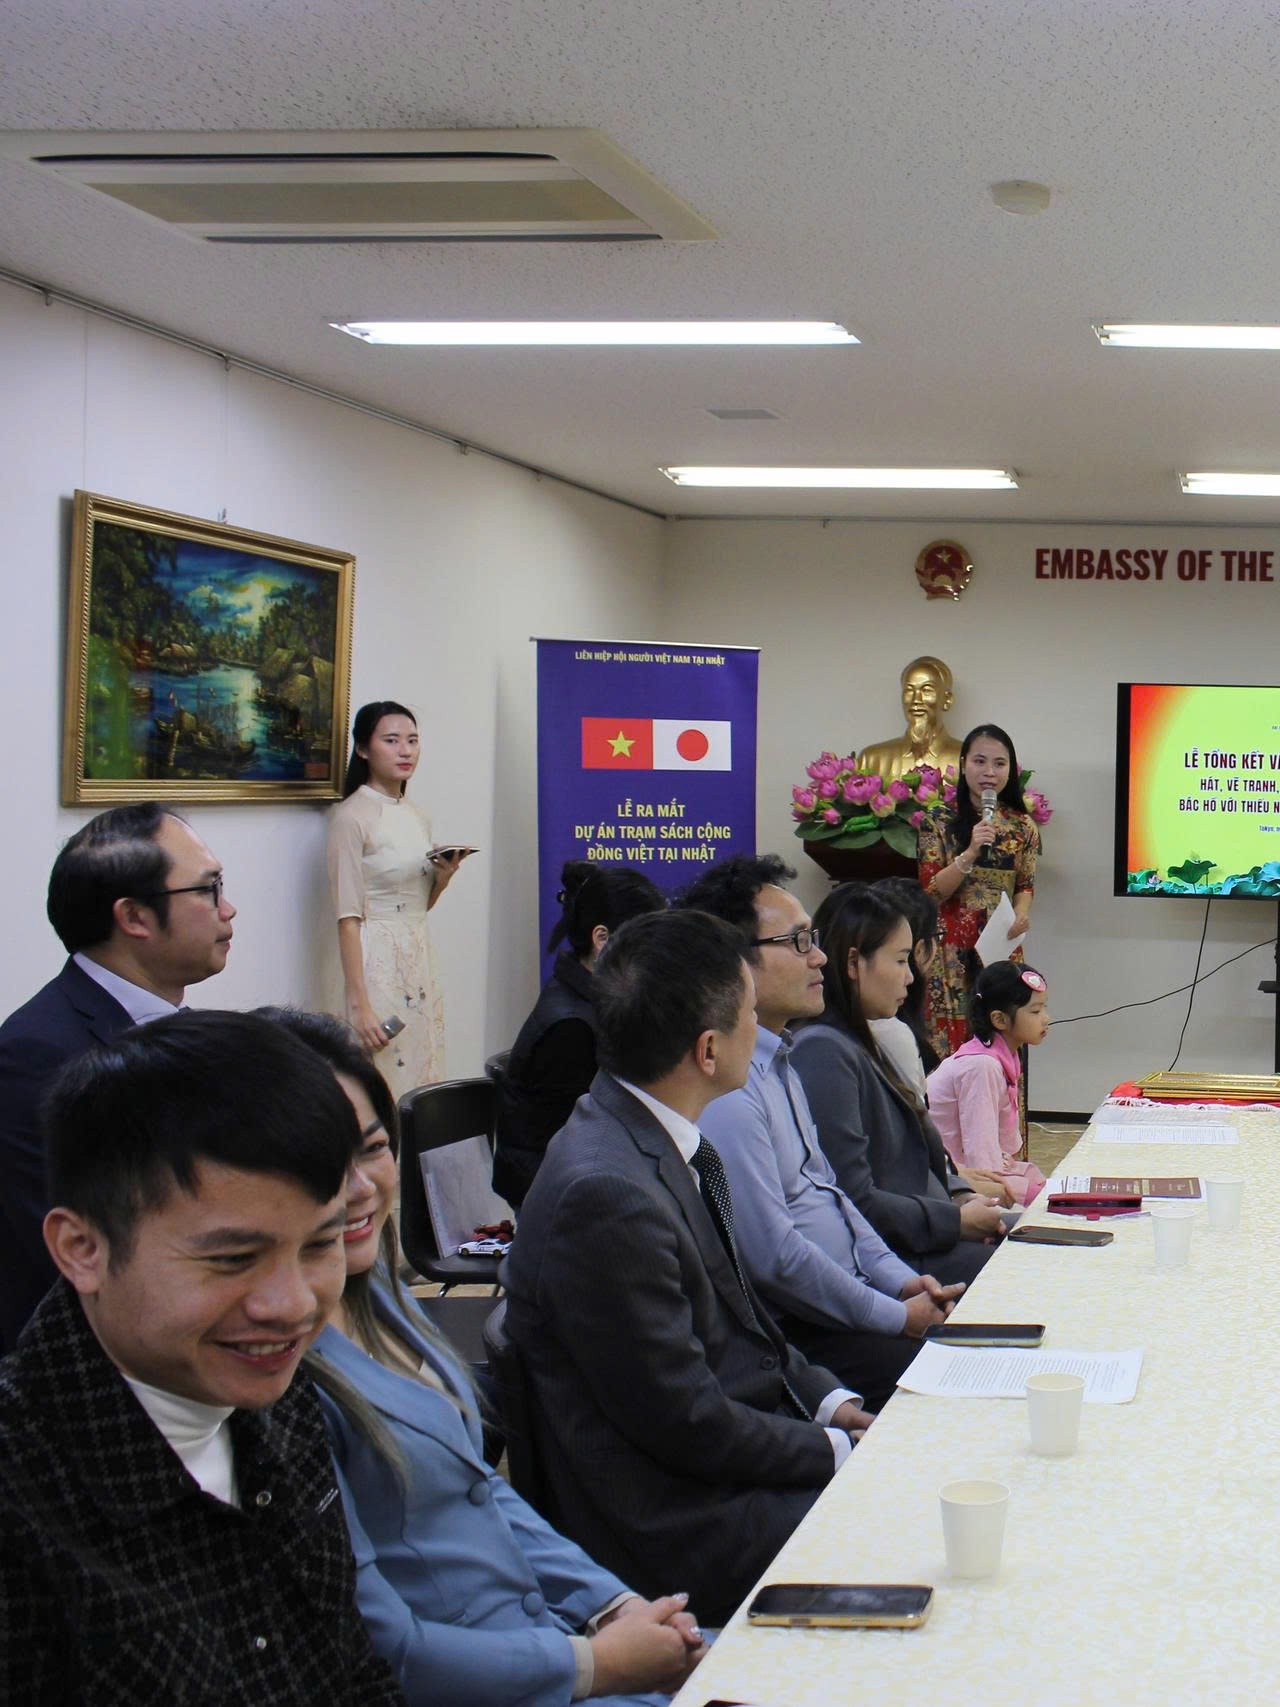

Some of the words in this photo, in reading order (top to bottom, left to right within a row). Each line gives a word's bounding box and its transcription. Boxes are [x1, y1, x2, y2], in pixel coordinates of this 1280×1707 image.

[1035, 549, 1169, 580] EMBASSY
[1177, 549, 1213, 581] OF
[1220, 551, 1275, 582] THE
[575, 650, 593, 660] LIÊN
[594, 650, 612, 662] HIỆP
[613, 651, 627, 663] HỘI
[628, 652, 654, 662] NGƯỜI
[654, 652, 671, 665] VIỆT
[672, 655, 691, 664] NAM
[692, 655, 705, 666] TẠI
[705, 654, 726, 667] NHẬT
[1184, 747, 1199, 768] LỄ
[1242, 751, 1264, 769] KẾT
[1200, 776, 1223, 792] HÁT,
[1226, 777, 1240, 792] VẼ
[1243, 780, 1280, 794] TRANH,
[617, 798, 633, 817] LỄ
[636, 804, 654, 818] RA
[657, 798, 686, 818] MẮT
[1179, 796, 1199, 811] BÁC
[1220, 797, 1237, 813] VỚI
[1241, 798, 1270, 813] THIẾU
[575, 825, 595, 843] DỰ
[597, 821, 615, 840] ÁN
[619, 825, 656, 843] TRẠM
[659, 821, 693, 840] SÁCH
[696, 822, 732, 842] CỘNG
[587, 842, 623, 861] ĐỒNG
[626, 844, 654, 864] VIỆT
[658, 847, 678, 864] TẠI
[682, 845, 716, 864] NHẬT
